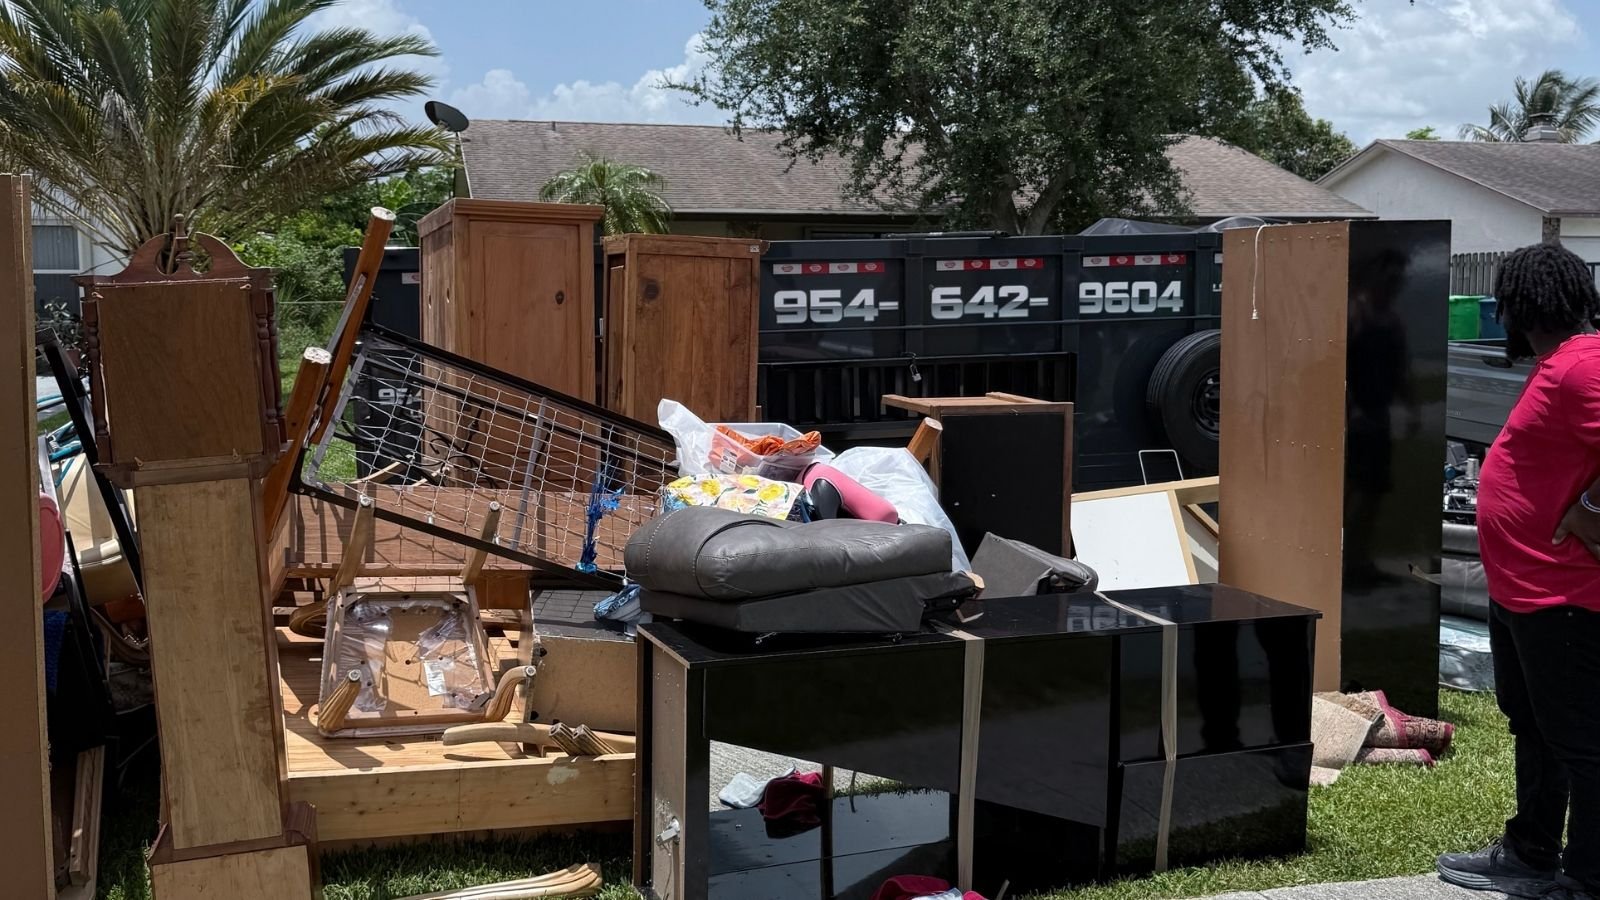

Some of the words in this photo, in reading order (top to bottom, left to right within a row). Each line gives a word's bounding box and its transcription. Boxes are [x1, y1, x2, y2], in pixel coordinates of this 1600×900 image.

[774, 289, 899, 323] 954-
[932, 285, 1049, 319] 642-
[1079, 281, 1184, 313] 9604
